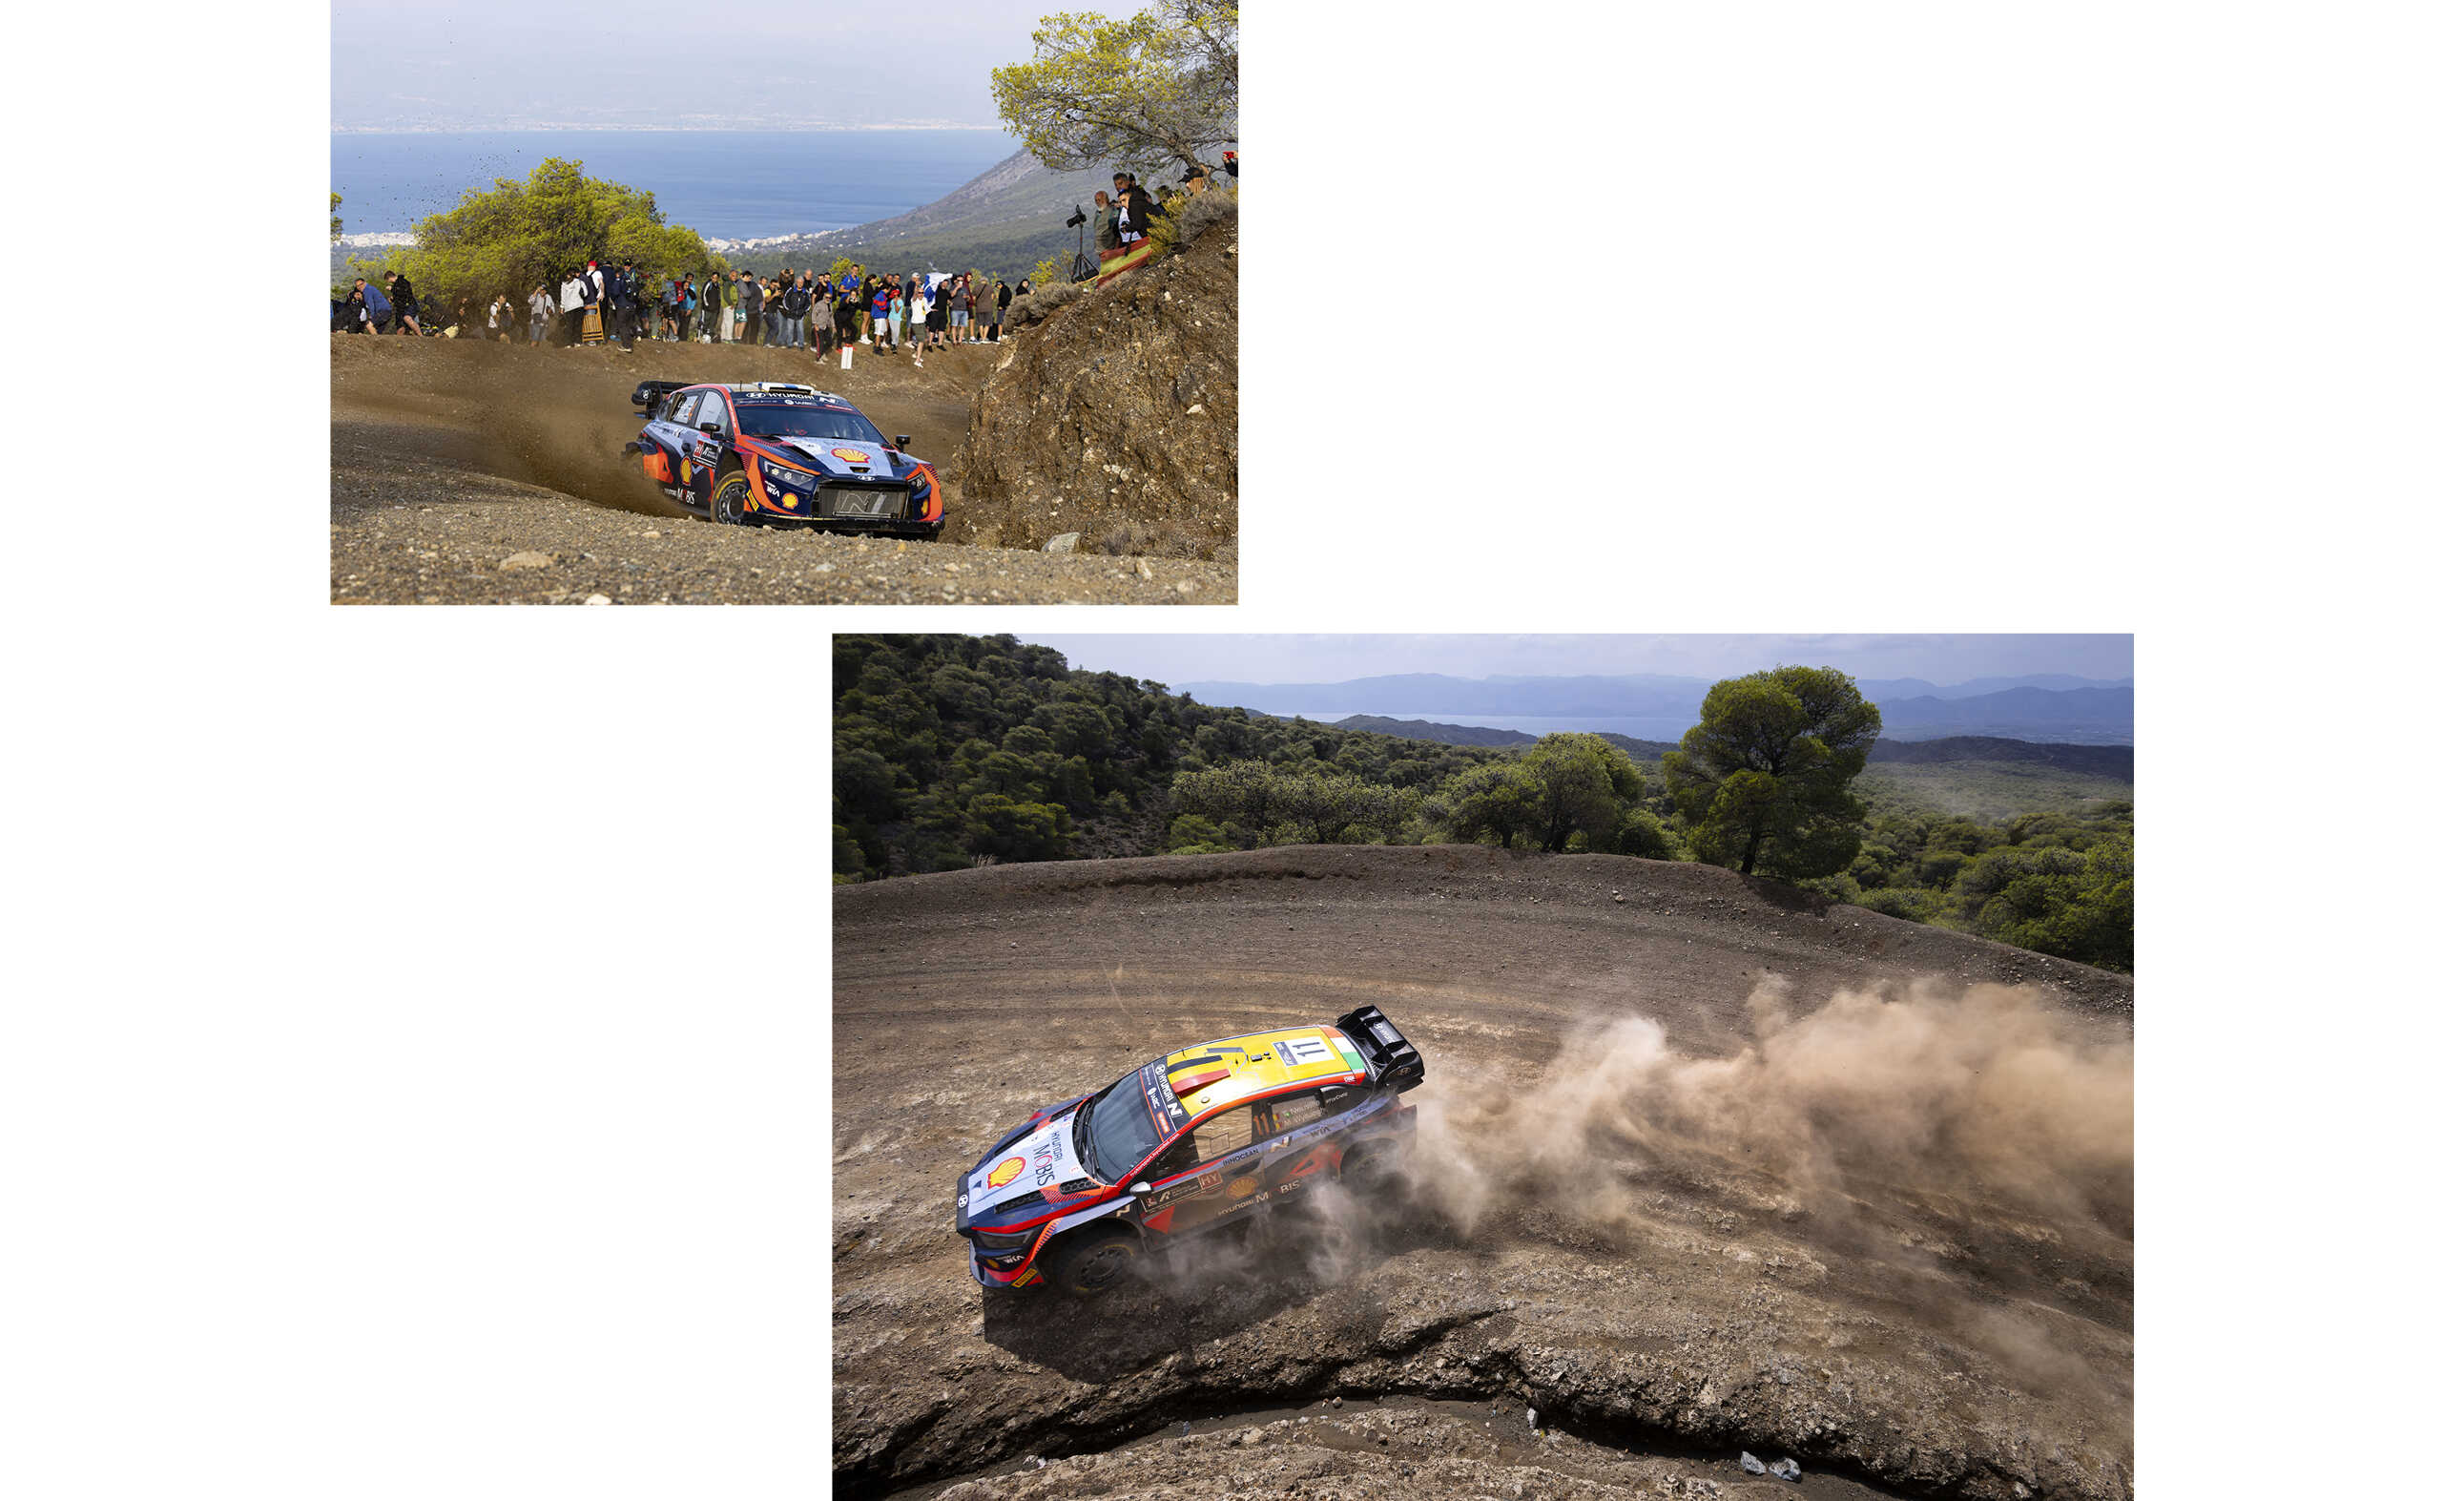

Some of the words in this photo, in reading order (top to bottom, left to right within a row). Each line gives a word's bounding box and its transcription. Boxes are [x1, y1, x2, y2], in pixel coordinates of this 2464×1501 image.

[1292, 1041, 1326, 1057] 11
[1158, 1074, 1175, 1102] HYUNDAI
[1253, 1113, 1270, 1136] 11
[1051, 1130, 1063, 1162] HYUNDAI
[1033, 1143, 1055, 1186] MOBIS
[1255, 1180, 1301, 1203] MBIS
